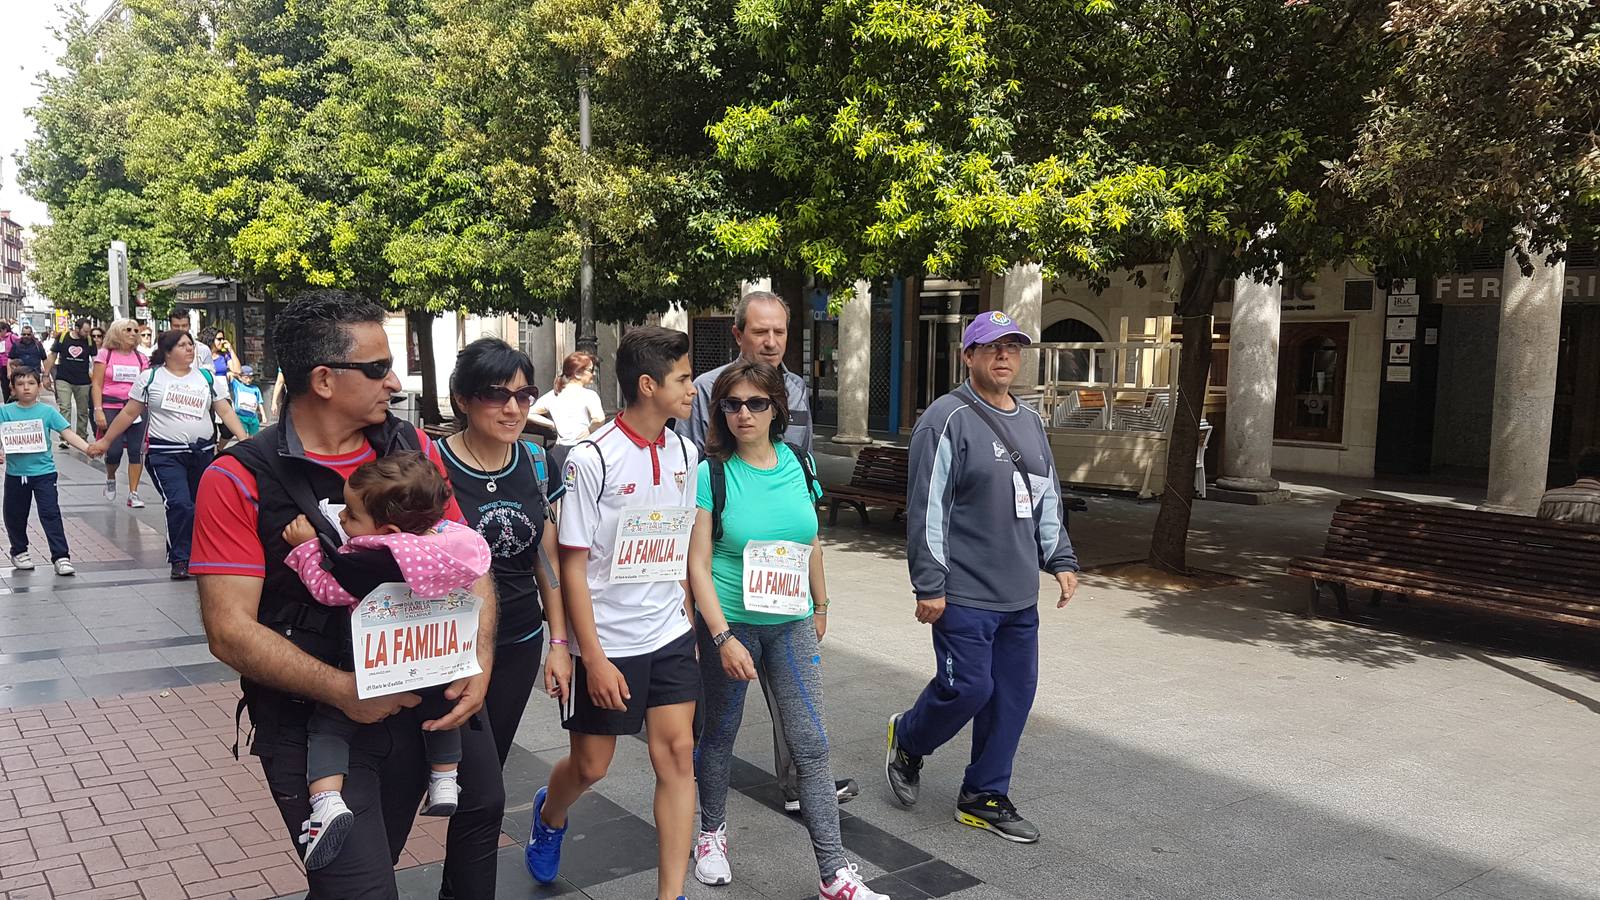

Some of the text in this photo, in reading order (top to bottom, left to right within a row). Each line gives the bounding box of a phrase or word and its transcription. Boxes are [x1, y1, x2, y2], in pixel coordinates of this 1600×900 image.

[617, 540, 633, 565] LA
[749, 570, 763, 593] LA
[365, 630, 388, 669] LA
